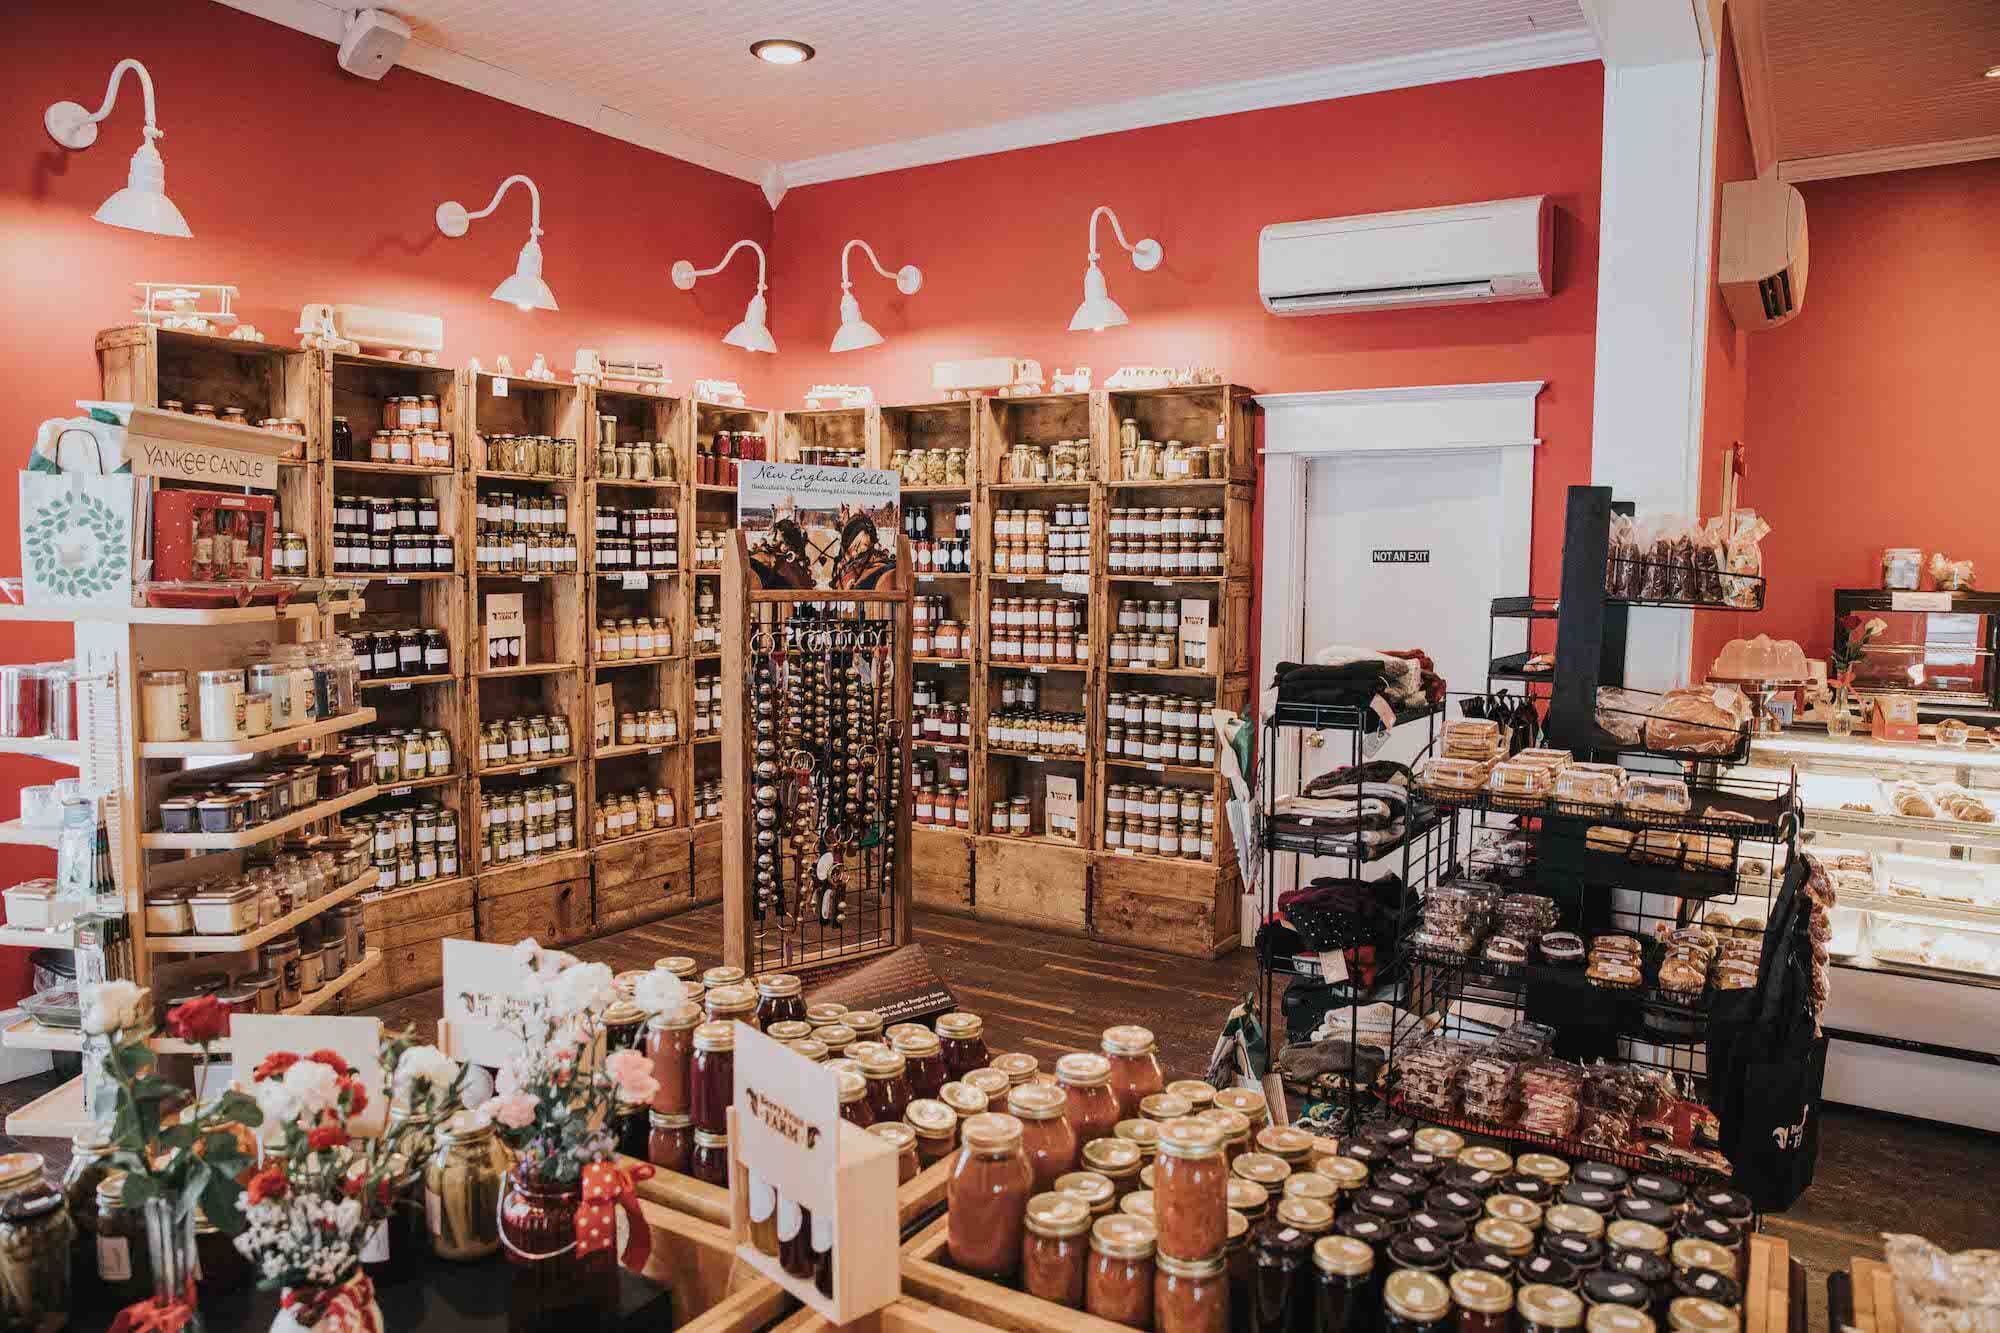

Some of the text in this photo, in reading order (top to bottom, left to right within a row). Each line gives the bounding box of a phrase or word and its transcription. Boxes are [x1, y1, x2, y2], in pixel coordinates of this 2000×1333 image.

[752, 464, 890, 488] New England Bells
[1373, 551, 1429, 561] NOT AN EXIT
